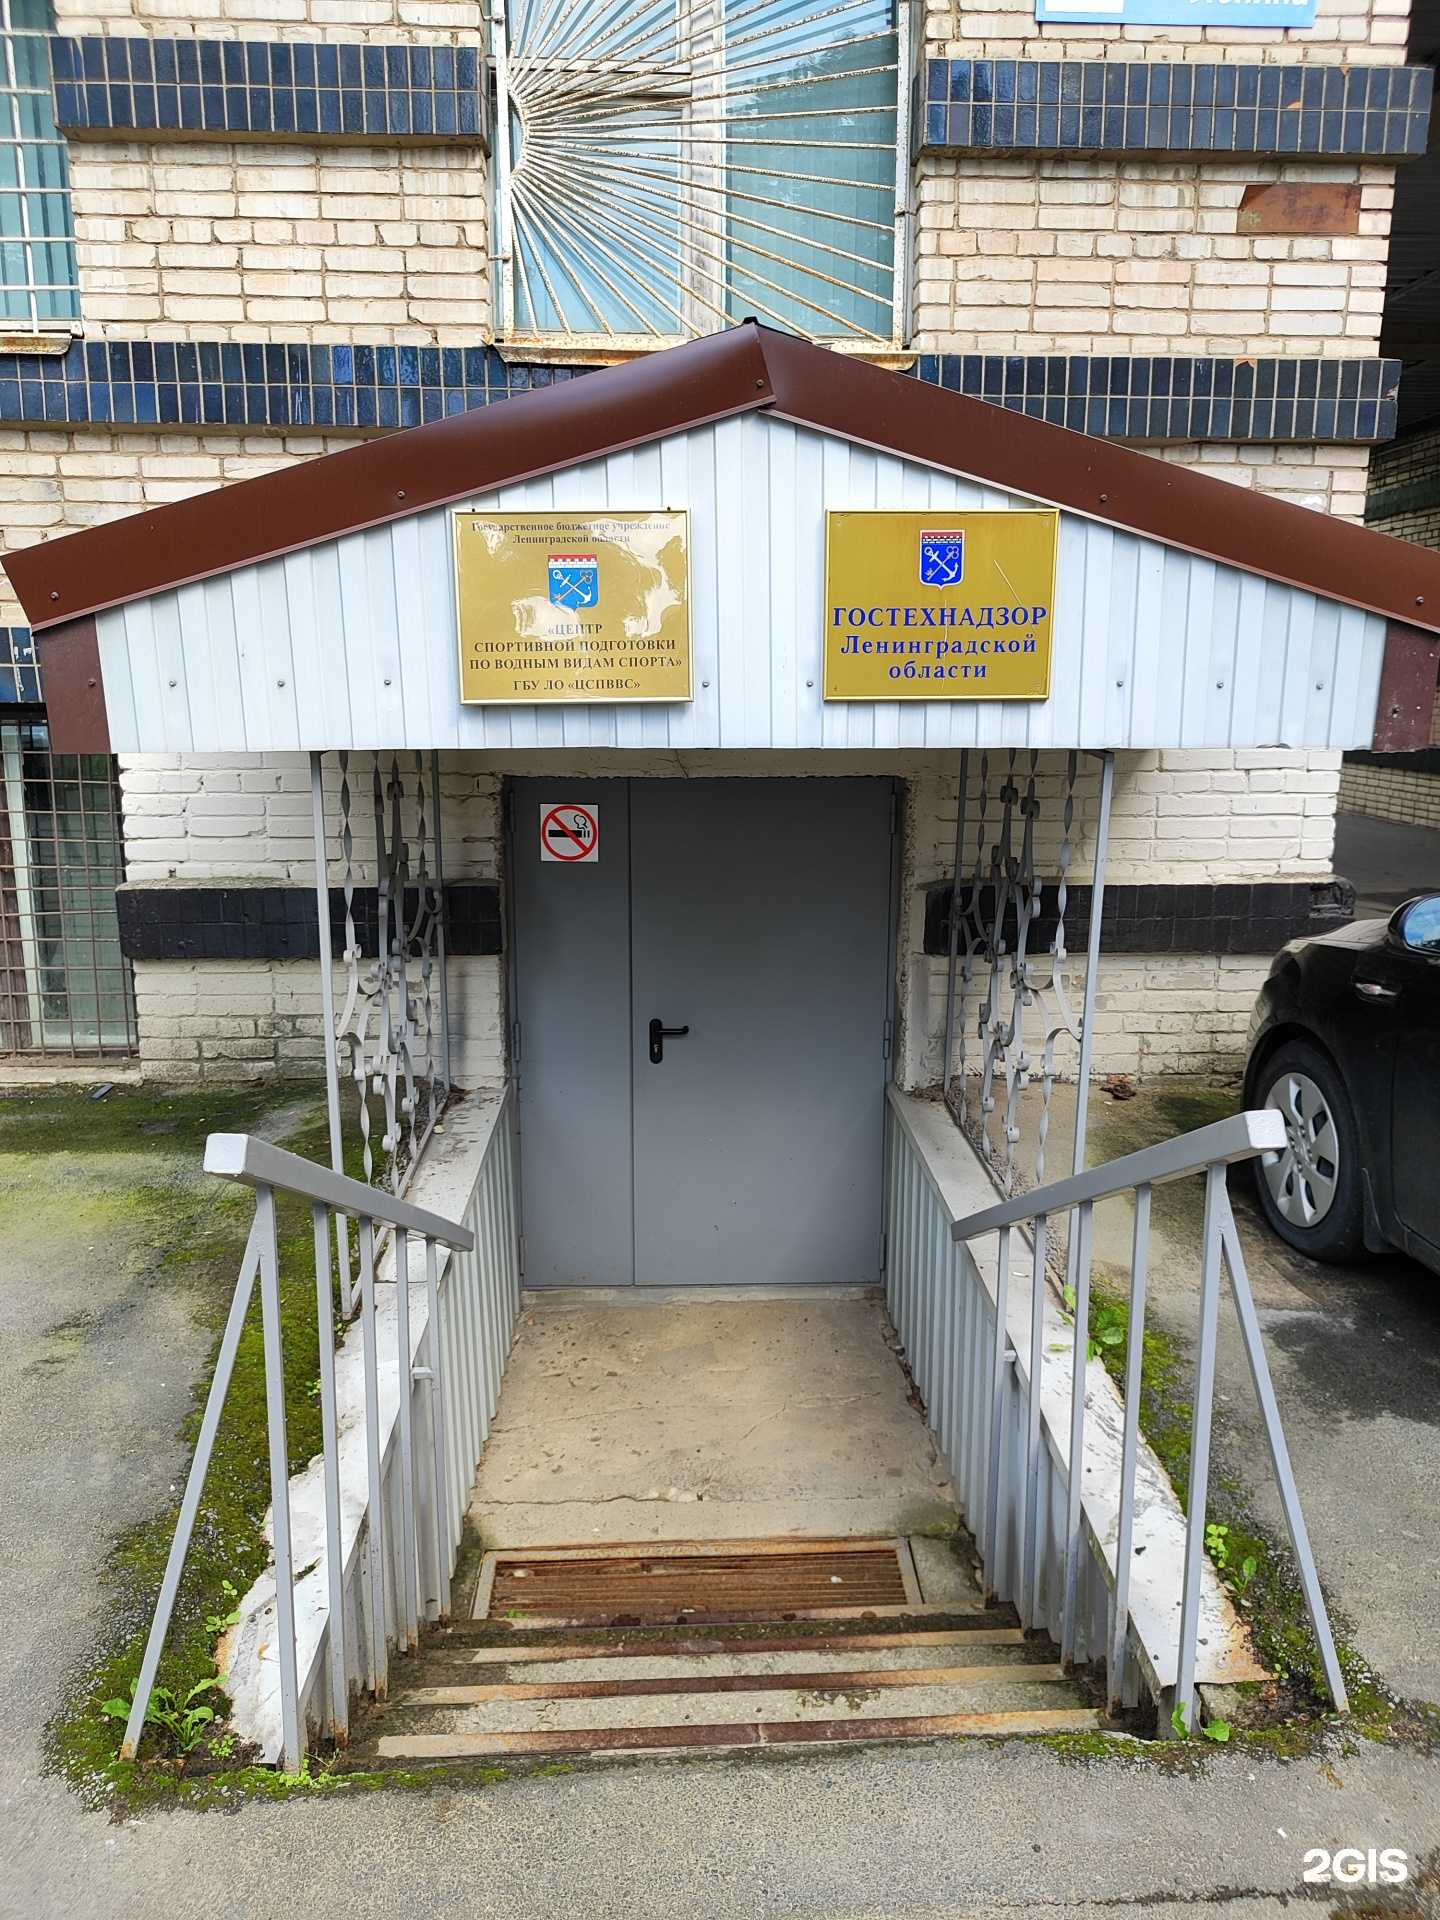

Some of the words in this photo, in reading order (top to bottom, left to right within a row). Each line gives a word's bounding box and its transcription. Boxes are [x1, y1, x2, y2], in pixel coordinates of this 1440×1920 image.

[513, 534, 589, 545] Ленинградской
[833, 606, 1047, 630] ГОСТЕХНАДЗОР
[548, 624, 603, 636] «ЦЕНТР
[474, 640, 575, 653] СПОРТИВНОЙ
[580, 639, 676, 653] ПОДГОТОВКИ
[840, 633, 1036, 658] Ленинградской
[470, 658, 492, 670] ПО
[495, 658, 559, 670] ВОДНЫМ
[564, 658, 615, 670] ВИДАМ
[619, 656, 682, 668] СПОРТА»
[888, 660, 987, 680] области
[513, 680, 540, 691] ГБУ
[544, 680, 564, 691] ЛО
[568, 679, 641, 691] «ЦСПВВС»
